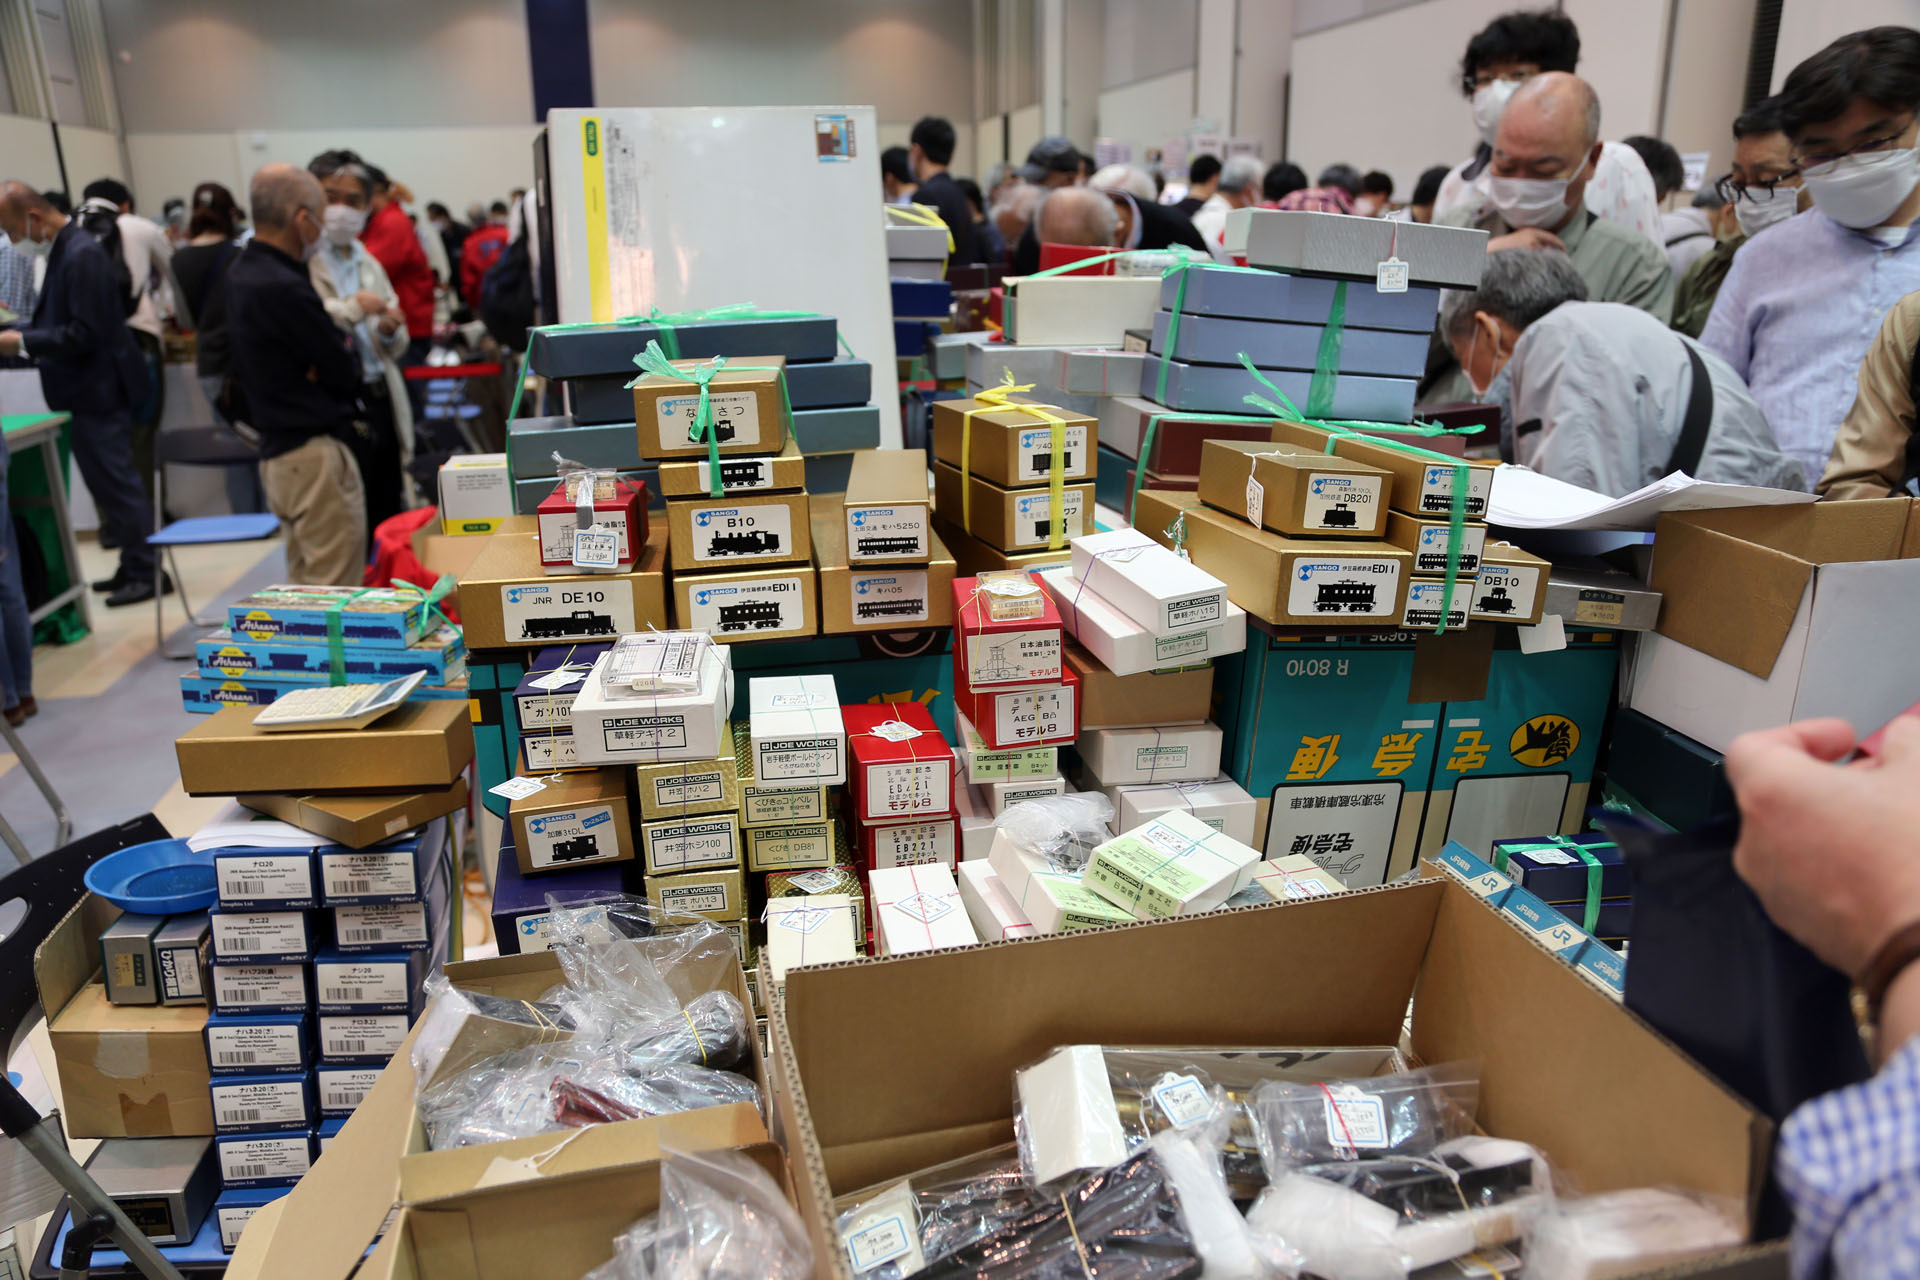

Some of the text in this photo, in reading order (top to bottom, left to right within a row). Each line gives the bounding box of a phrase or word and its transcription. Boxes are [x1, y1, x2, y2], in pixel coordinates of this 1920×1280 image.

[686, 405, 745, 417] なさつ
[1343, 494, 1372, 504] DB201
[727, 516, 755, 527] B10
[880, 522, 920, 530] モハ5250
[1484, 575, 1520, 587] DB10
[532, 596, 553, 605] JNR
[1192, 595, 1219, 605] WORKS
[240, 620, 281, 632] Athearn
[212, 656, 253, 668] Athearn
[1287, 659, 1348, 676] R 8010
[213, 690, 254, 702] Athearn
[640, 716, 683, 725] WORKS
[1013, 714, 1035, 722] AEG
[614, 728, 676, 740] 草軽デキ12
[1015, 723, 1057, 738] モデル8
[773, 739, 837, 750] JOE WORKS
[685, 773, 720, 782] WORKS
[668, 784, 710, 795] 井笠 ホハ2
[1028, 789, 1056, 797] WORKS
[754, 795, 812, 807] くびきのコッペル
[888, 797, 932, 811] モデル8
[544, 814, 574, 823] SANGO
[664, 823, 731, 836] JOE WORKS
[787, 827, 827, 836] WORKS
[664, 839, 721, 854] 井笠ホジ100
[768, 843, 815, 853] くびき DB81
[896, 841, 934, 853] EB221
[252, 860, 274, 868] ナロ20
[1103, 863, 1118, 877] JOE
[1117, 870, 1144, 890] WORKS
[1481, 876, 1499, 892] JR
[689, 886, 724, 894] WORKS
[690, 896, 717, 904] ホハ13
[1552, 927, 1572, 945] JR
